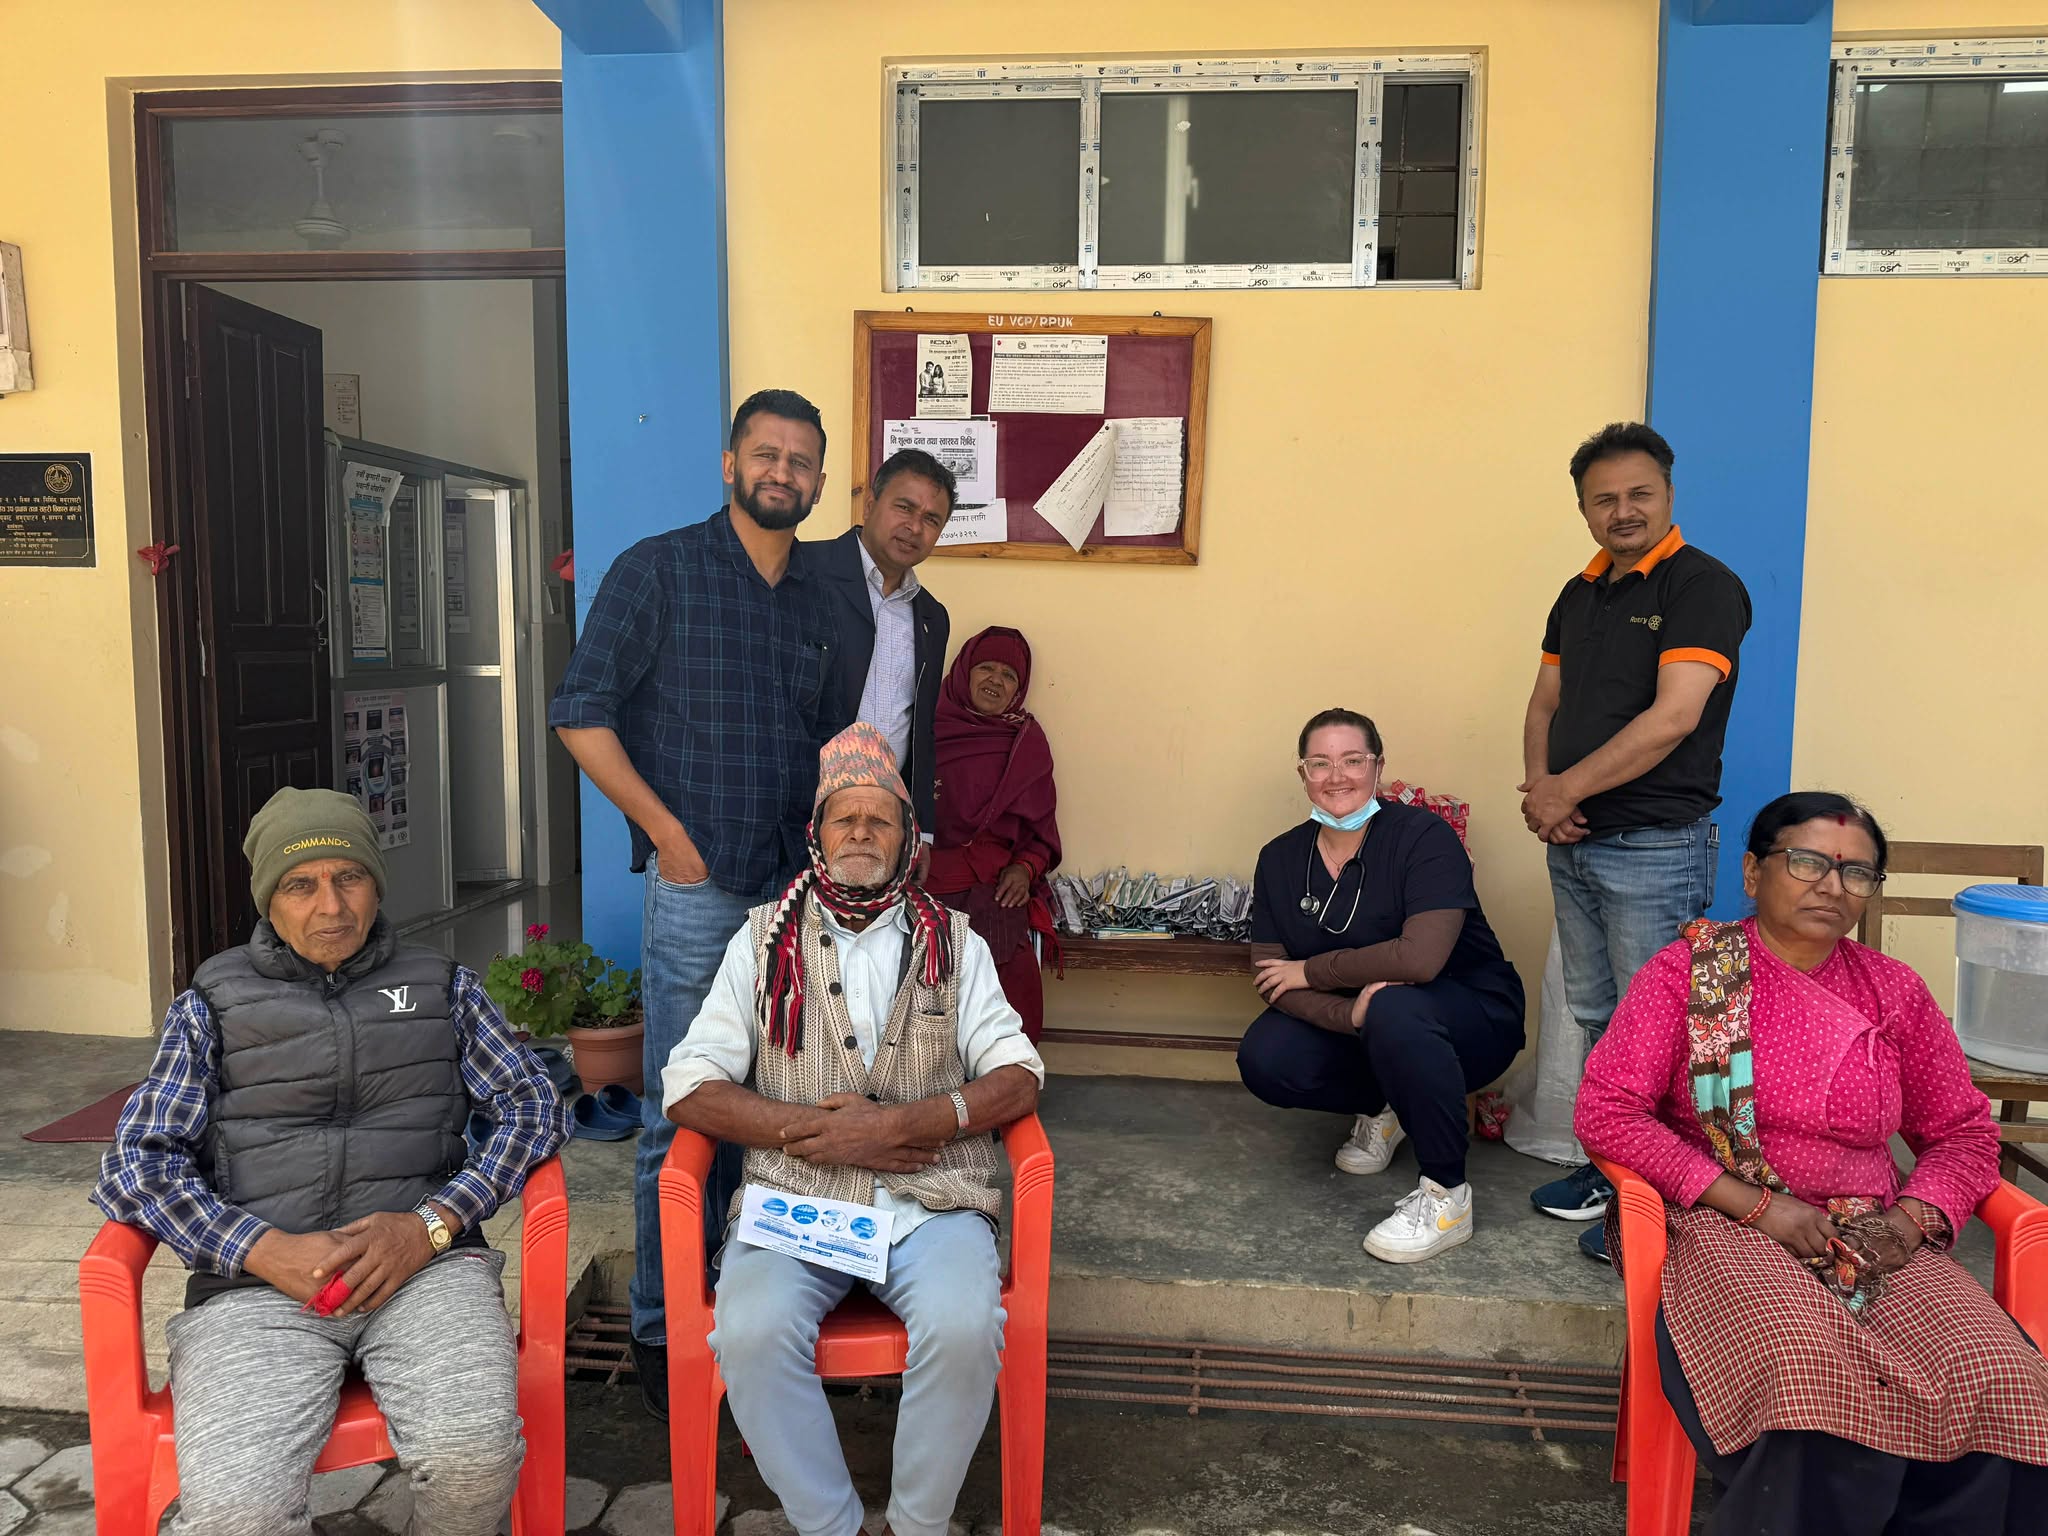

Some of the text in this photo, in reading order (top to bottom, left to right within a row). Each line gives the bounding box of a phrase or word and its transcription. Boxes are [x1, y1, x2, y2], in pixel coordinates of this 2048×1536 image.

[988, 315, 1004, 327] EU
[927, 437, 938, 445] तथा
[283, 836, 351, 855] COMMANDO
